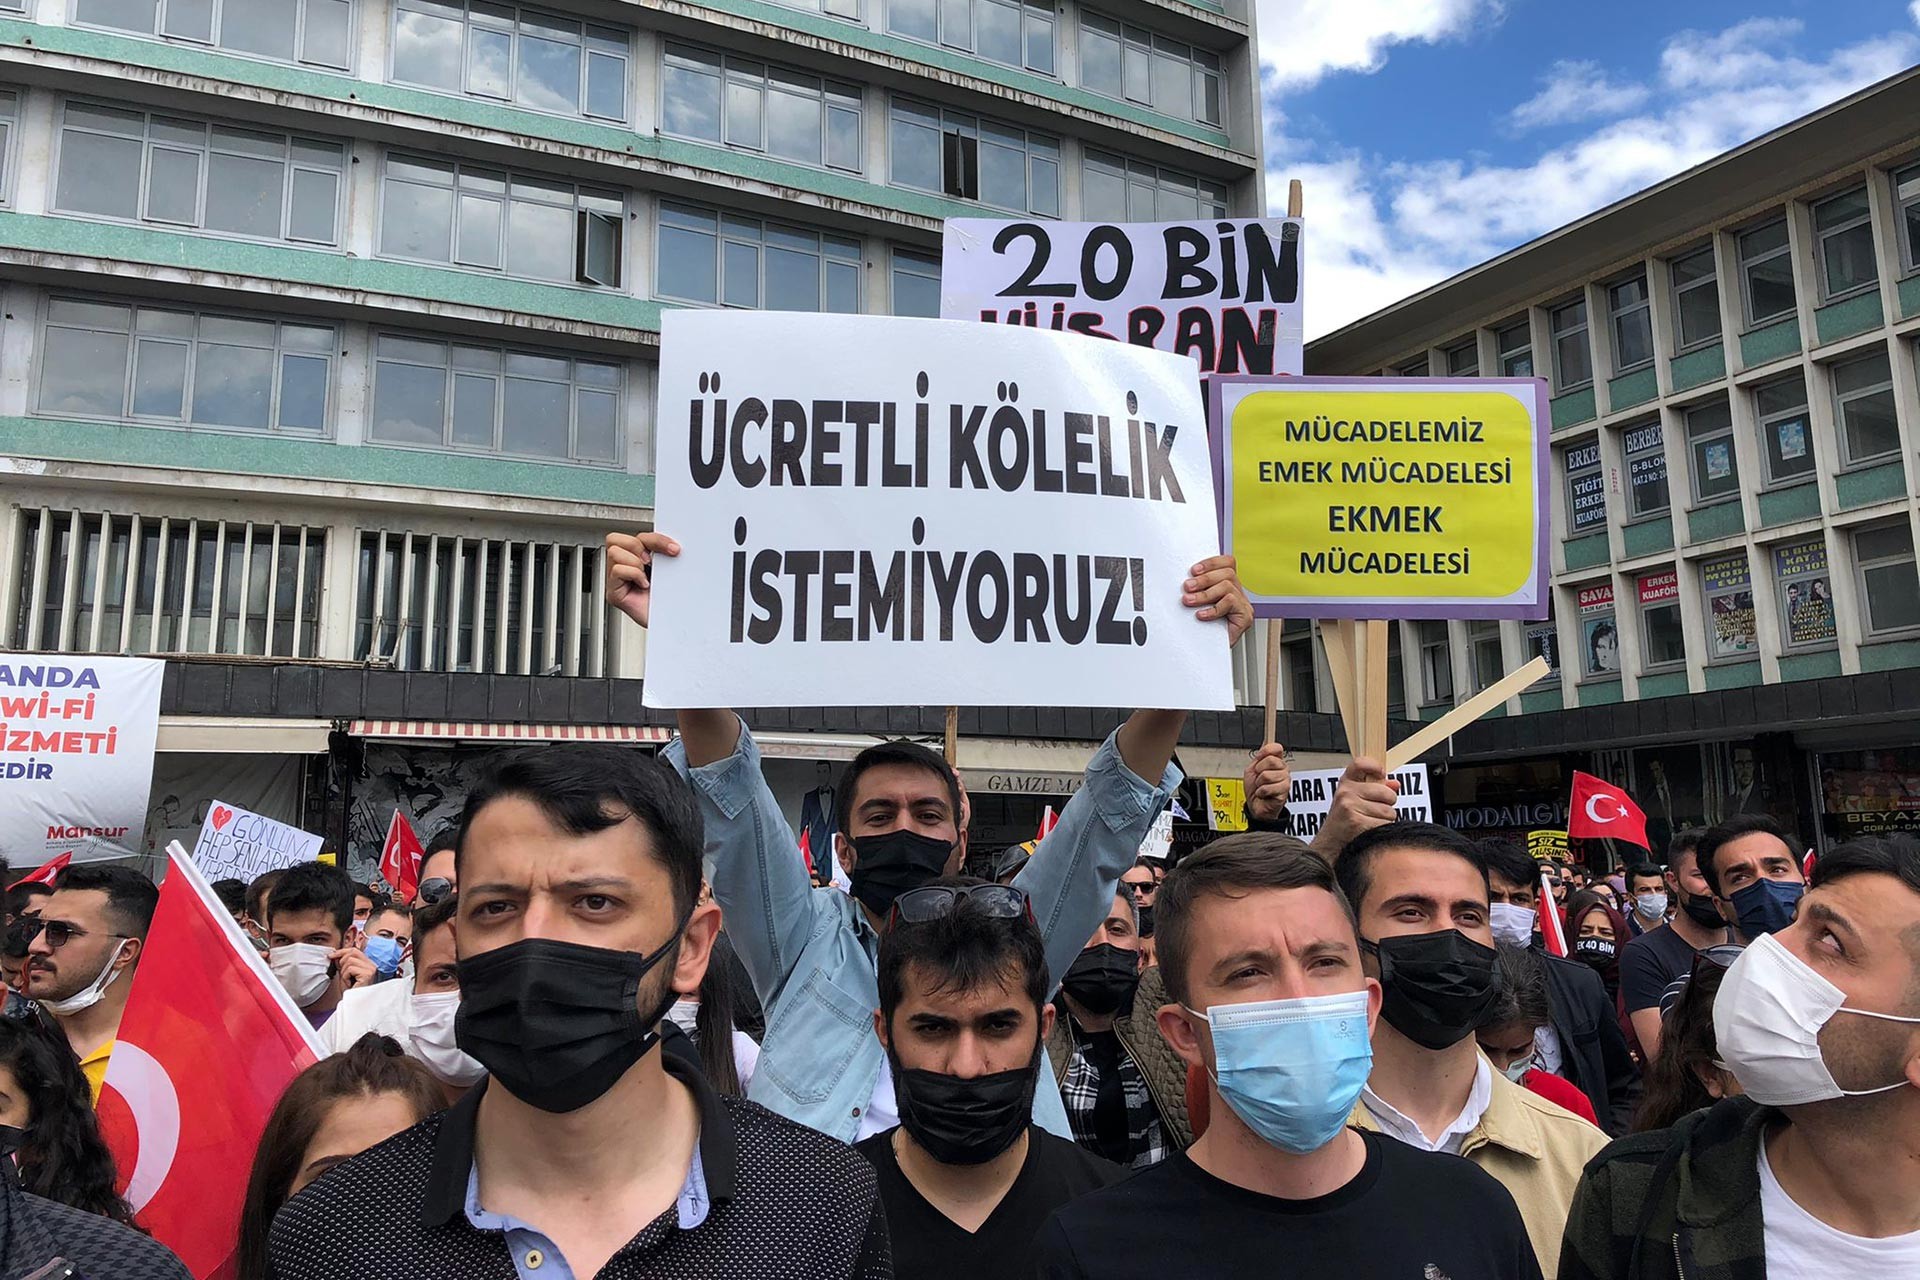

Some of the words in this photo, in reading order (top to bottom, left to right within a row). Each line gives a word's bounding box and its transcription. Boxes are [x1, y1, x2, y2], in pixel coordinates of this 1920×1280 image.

[1160, 222, 1300, 304] BİN
[688, 370, 929, 490] ÜCRETLİ
[949, 381, 1187, 504] KÖLELİK
[1284, 415, 1484, 443] MÜCADELEMİZ
[1258, 461, 1334, 483] EMEK
[1341, 456, 1512, 484] MÜCADELESİ
[1328, 505, 1444, 533] EKMEK
[1299, 546, 1470, 575] MÜCADELESİ
[729, 515, 1148, 647] İSTEMİYORUZ!
[1581, 586, 1613, 603] SAVA
[1647, 575, 1676, 587] ERKEK
[988, 775, 1053, 793] GAMZE
[47, 825, 128, 839] Mansur
[198, 829, 231, 860] HEP
[232, 814, 309, 858] GÖNLÜM
[1585, 940, 1597, 950] 40
[1598, 942, 1615, 954] BİN
